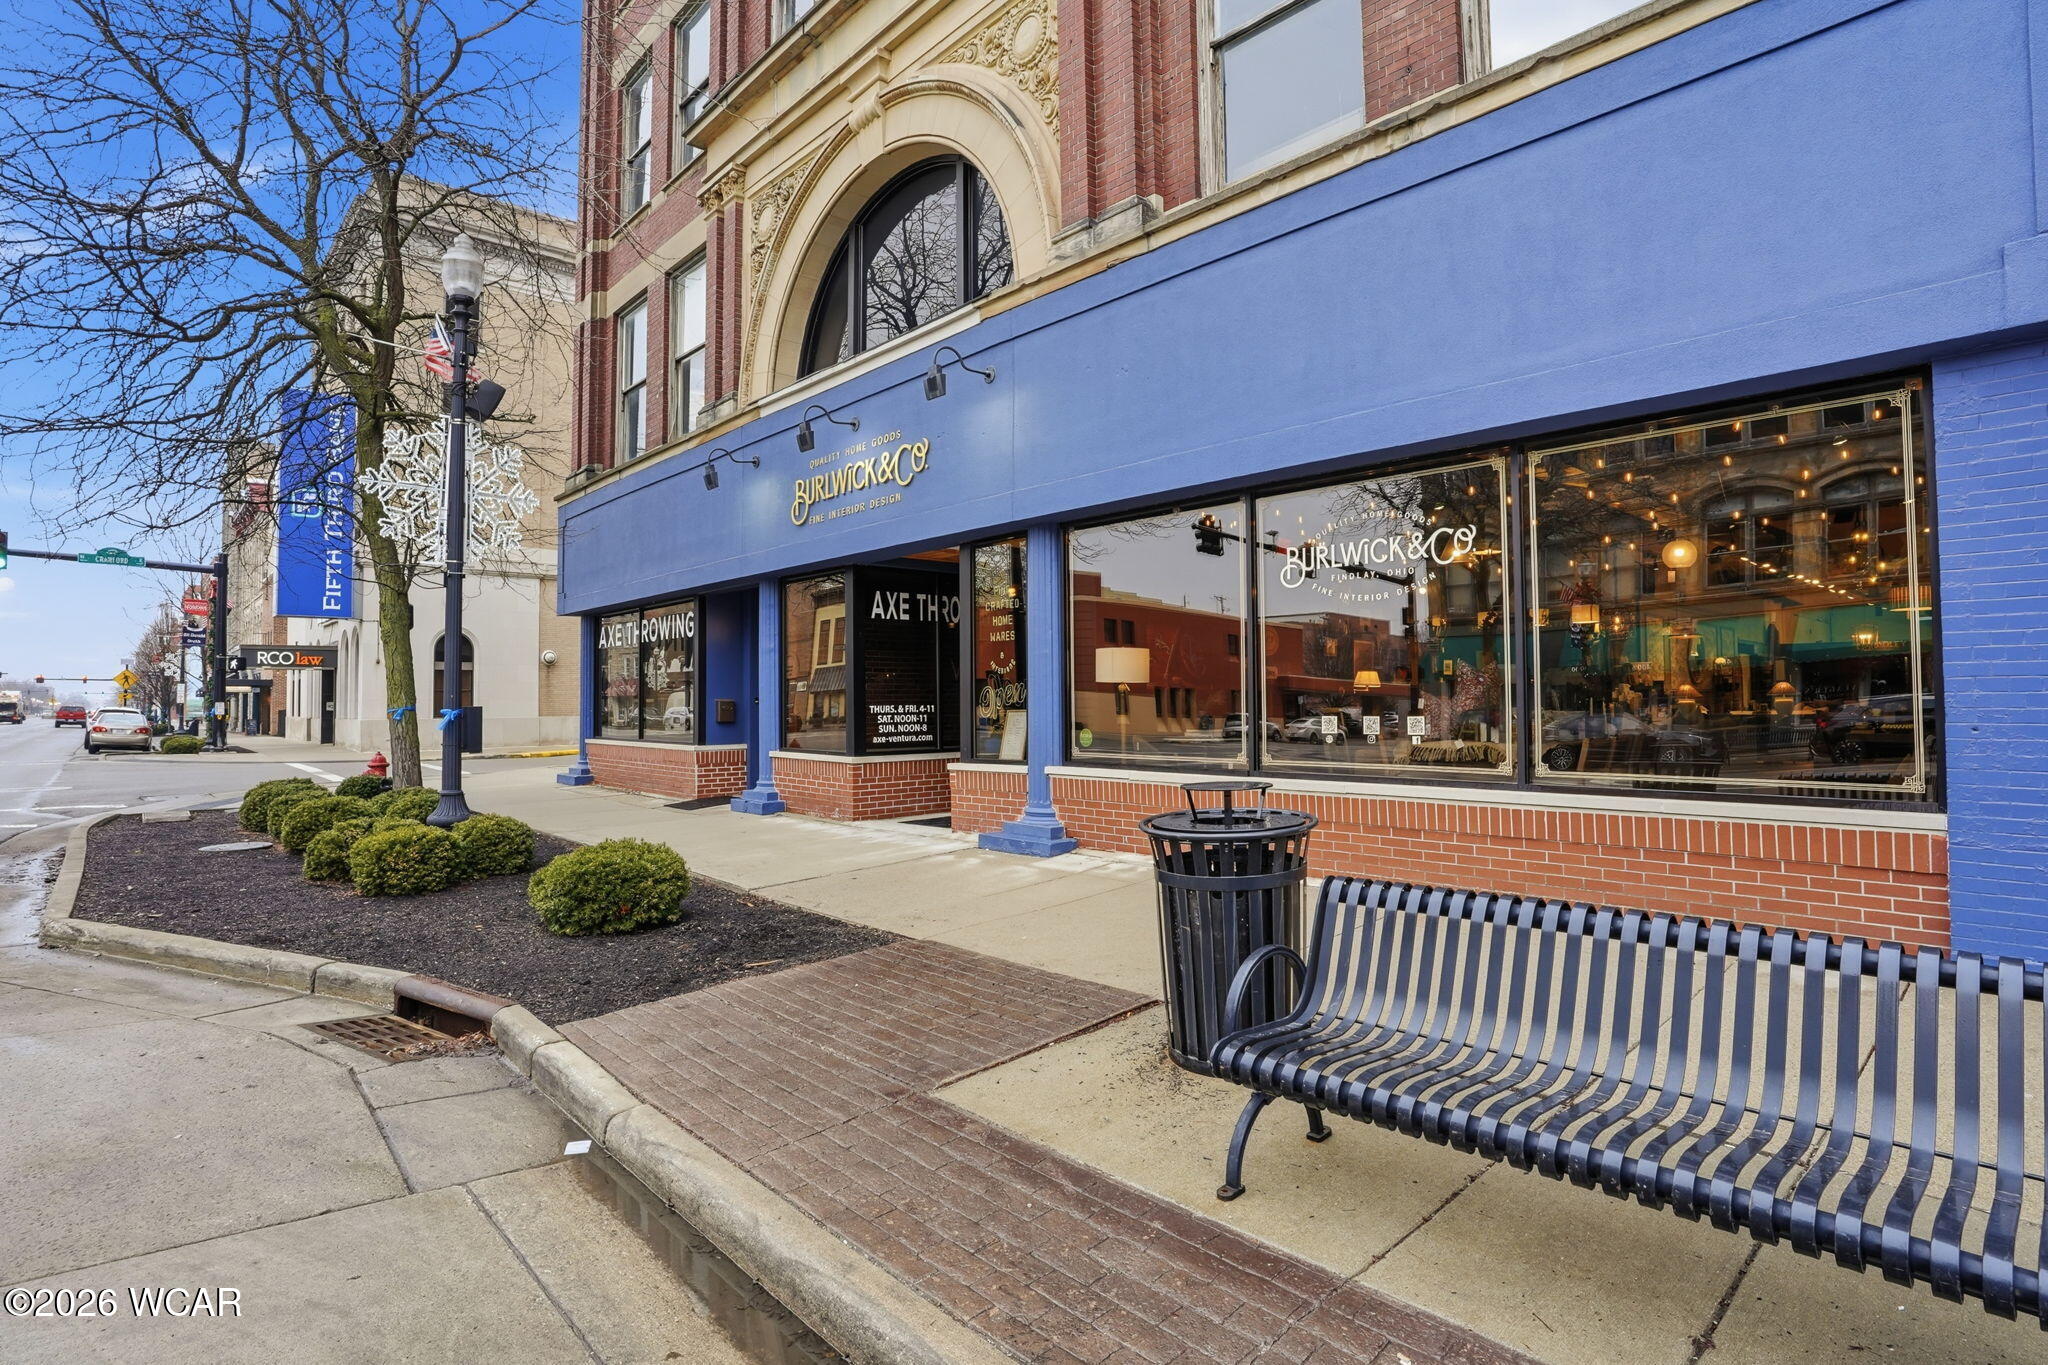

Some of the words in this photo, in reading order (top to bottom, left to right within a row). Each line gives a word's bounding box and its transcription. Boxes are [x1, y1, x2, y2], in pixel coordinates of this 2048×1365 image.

[810, 450, 840, 469] QUALITY
[845, 441, 866, 456] HOME
[871, 430, 901, 448] GOODS
[325, 472, 344, 541] THIRD
[809, 514, 825, 525] FINE
[828, 502, 866, 519] INTERIOR
[870, 493, 901, 508] DESIGN
[1316, 516, 1355, 540] QUALITY
[1362, 511, 1389, 519] HOME
[1398, 511, 1432, 526] GOODS
[323, 549, 342, 610] FIFTH
[1312, 583, 1333, 597] FINE
[1340, 592, 1390, 602] INTERIOR
[1397, 571, 1436, 595] DESIGN
[1331, 570, 1379, 581] FINDLAY,
[1387, 567, 1415, 576] OHIO
[871, 590, 910, 620] AXE
[599, 624, 622, 649] AXE
[627, 611, 694, 645] THROWING
[992, 615, 1013, 626] HOME
[990, 631, 1015, 642] WARES
[257, 652, 294, 665] RCO
[295, 652, 324, 665] law
[877, 715, 893, 723] SAT.
[894, 715, 927, 723] NOON-11
[898, 705, 904, 713] &
[872, 734, 933, 743] axe-ventura.com
